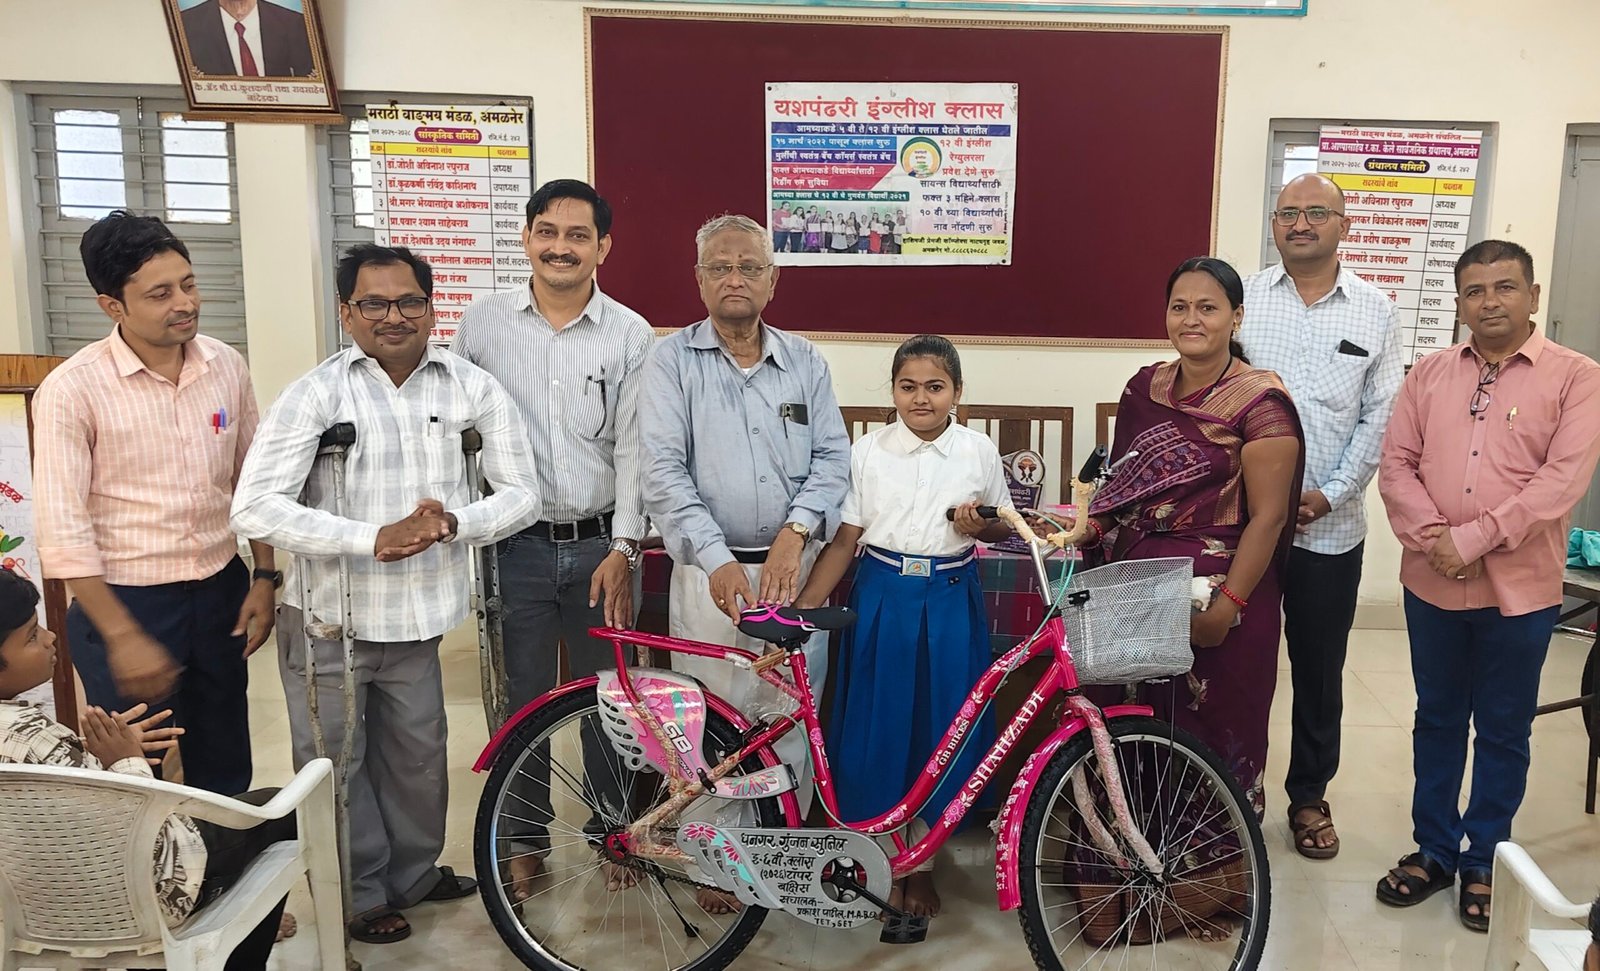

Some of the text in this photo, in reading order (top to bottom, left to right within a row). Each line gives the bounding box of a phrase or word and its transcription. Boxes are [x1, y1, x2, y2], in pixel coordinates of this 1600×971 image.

[774, 95, 1004, 120] यशपंढरी इंग्लीश क्लास
[368, 107, 399, 120] मराठी
[446, 107, 477, 125] मंडळ,
[480, 109, 523, 124] अमळनेर
[417, 128, 480, 142] सांस्कृतिक समिती
[797, 124, 836, 133] आमच्याकडे
[839, 126, 845, 134] ५
[848, 124, 856, 134] वी
[859, 124, 865, 134] ते
[881, 124, 890, 134] वी
[892, 125, 915, 135] इंग्लीश
[918, 126, 939, 135] क्लास
[942, 125, 960, 135] घेतले
[963, 125, 988, 135] जातील
[1341, 128, 1359, 136] मराठी
[807, 138, 826, 146] २०२२
[940, 138, 992, 148] १२ वी इंग्लीश
[387, 158, 414, 171] डॉ.जोशी
[416, 160, 445, 171] अविनाश
[493, 164, 513, 174] अध्यक्ष
[1368, 159, 1426, 171] ग्रंथालय समिती
[942, 167, 960, 176] प्रवेश
[965, 167, 977, 176] देणे
[378, 180, 383, 188] २
[493, 182, 520, 193] उपाध्यक्ष
[920, 180, 946, 188] सायन्स
[379, 198, 384, 206] ३
[923, 193, 1000, 204] फक्त ३ महिने क्लास
[1361, 193, 1389, 205] अविनाश
[456, 199, 489, 210] अशोकराव
[494, 199, 518, 213] कार्यवाह
[1435, 199, 1456, 210] अध्यक्ष
[934, 207, 943, 217] वी
[947, 209, 959, 217] च्या
[380, 218, 385, 226] ४
[437, 216, 468, 229] साहेबराव
[494, 218, 519, 231] कार्यवाह
[1433, 219, 1459, 230] उपाध्यक्ष
[435, 236, 450, 248] उदय
[452, 233, 476, 247] गंगाधर
[1363, 232, 1379, 244] प्रदीप
[1430, 237, 1455, 251] कार्यवाह
[1369, 251, 1408, 265] उदय गंगाधर
[450, 272, 467, 282] संजय
[1425, 278, 1444, 288] सदस्य
[1422, 297, 1441, 307] सदस्य
[1420, 316, 1439, 326] सदस्य
[1417, 335, 1437, 345] सदस्य
[938, 719, 970, 766] GB BIKES
[967, 691, 1045, 793] SHAHZADI
[779, 832, 810, 852] गुंजन
[811, 834, 846, 856] सुनिल
[797, 907, 820, 917] प्रकाश
